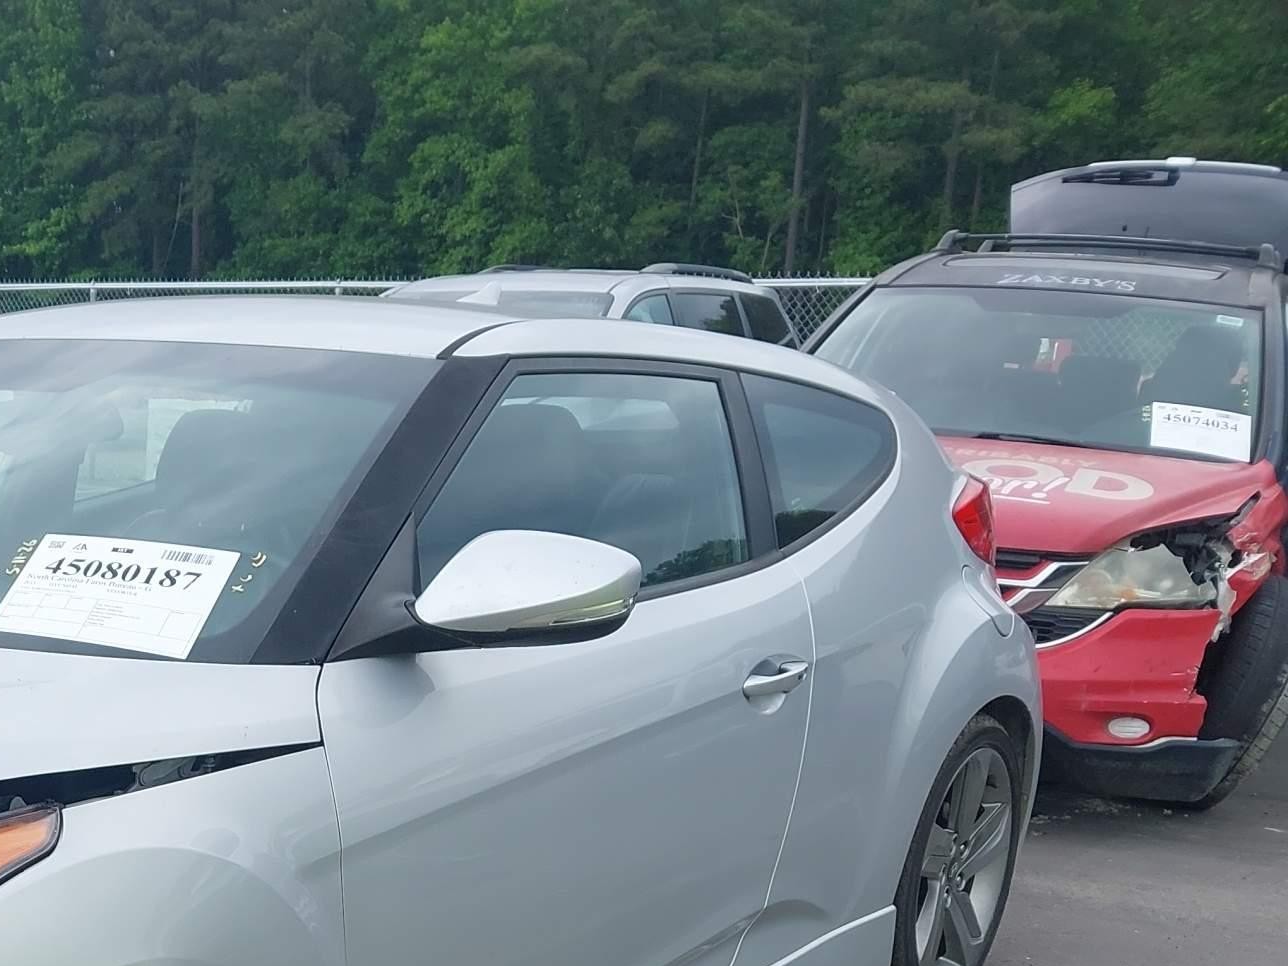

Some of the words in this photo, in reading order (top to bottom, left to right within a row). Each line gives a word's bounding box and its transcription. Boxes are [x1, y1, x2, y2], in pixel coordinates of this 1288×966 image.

[997, 273, 1137, 291] ZAXBY'S
[1162, 413, 1240, 432] 45074034
[44, 556, 203, 591] 45080187
